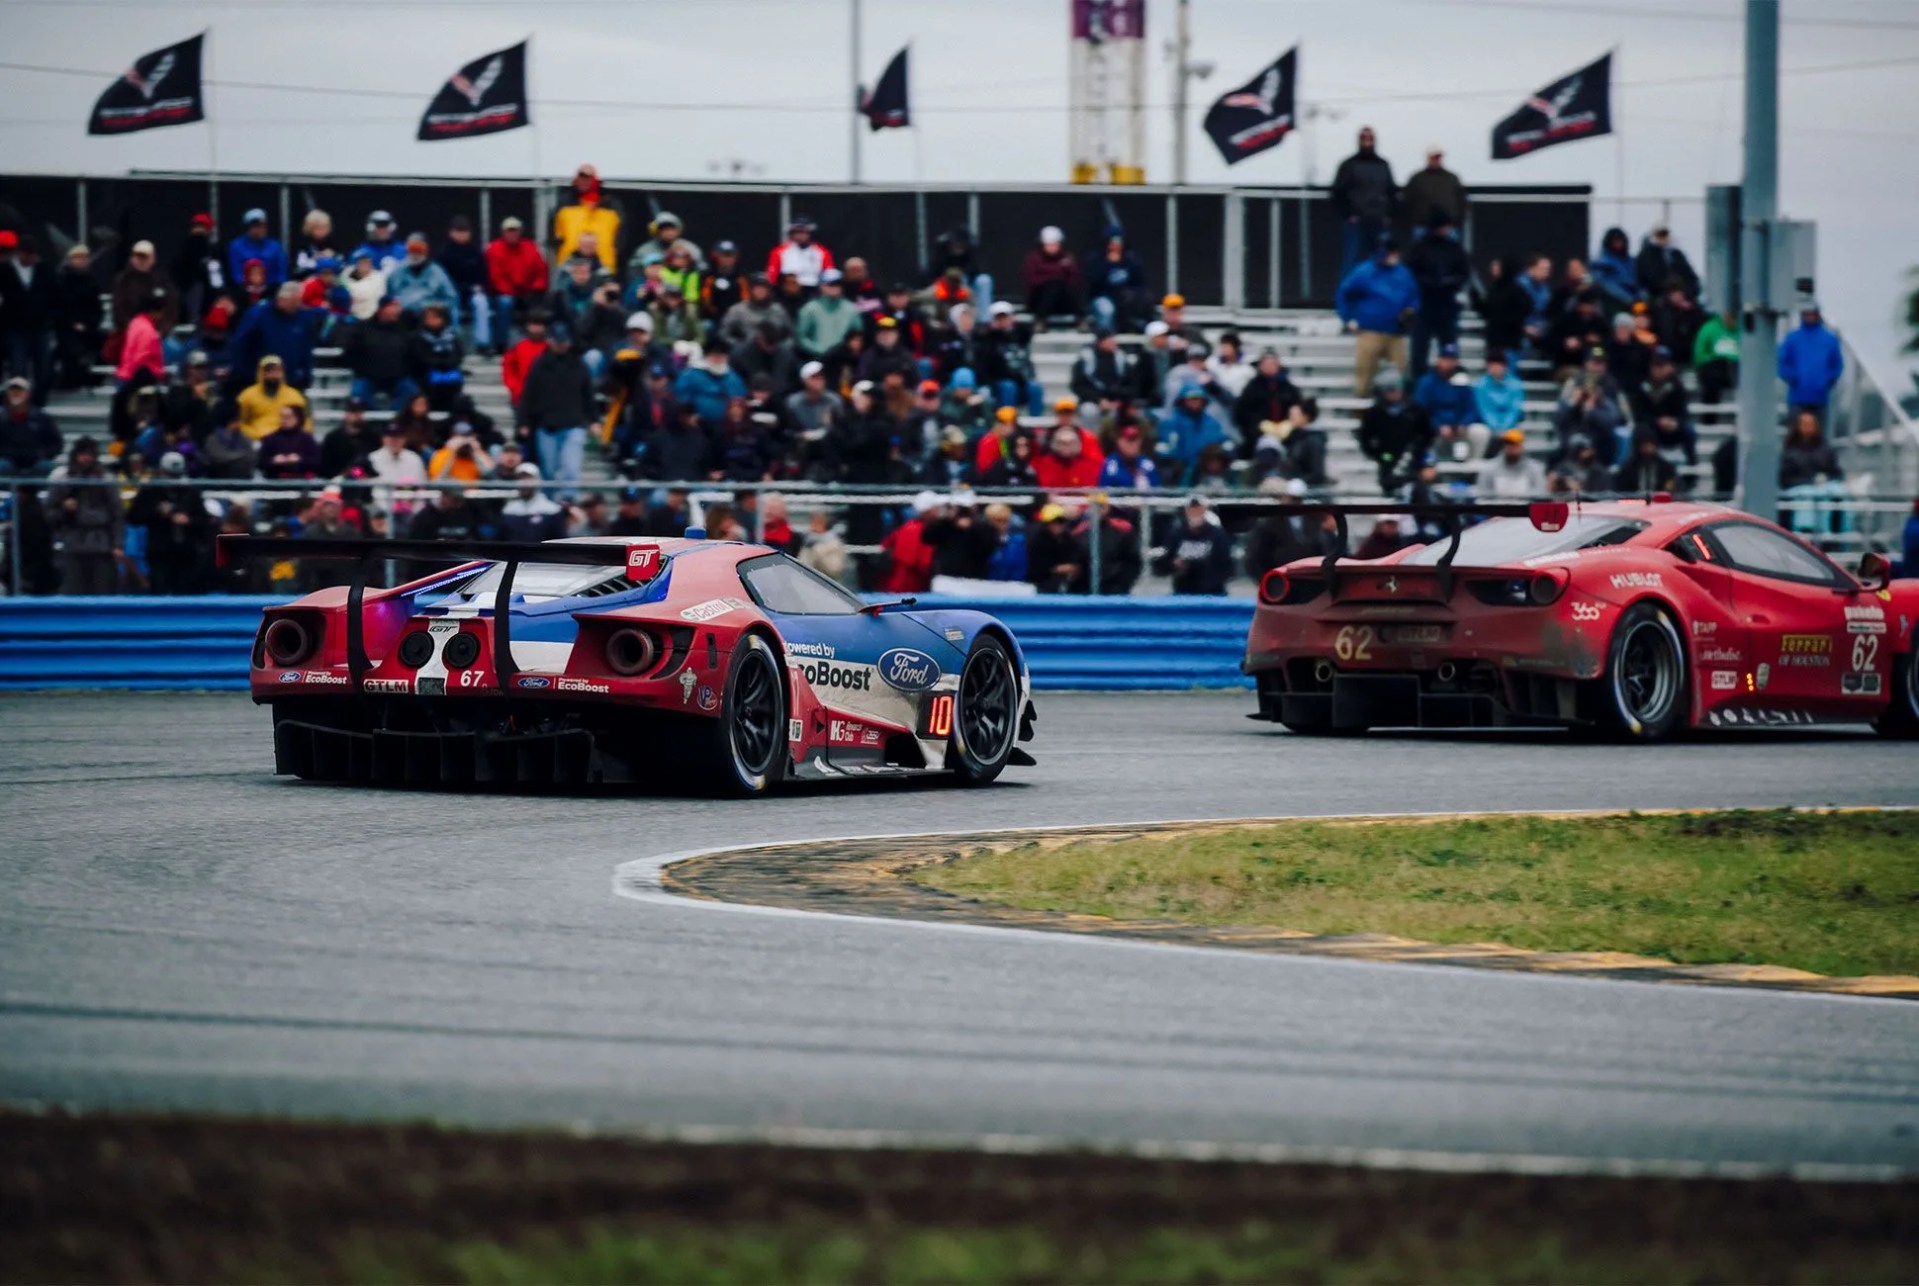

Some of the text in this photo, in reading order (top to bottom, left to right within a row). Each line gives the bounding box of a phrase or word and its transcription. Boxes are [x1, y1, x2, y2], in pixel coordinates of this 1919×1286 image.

[628, 549, 659, 568] GT
[823, 643, 835, 659] by
[1335, 625, 1373, 660] 62
[1852, 634, 1879, 671] 62
[889, 652, 930, 685] Ford
[305, 675, 347, 684] EcoBoost
[364, 680, 407, 692] GTLM
[460, 670, 484, 688] 67
[557, 682, 610, 694] EcoBoost
[929, 695, 953, 736] 10
